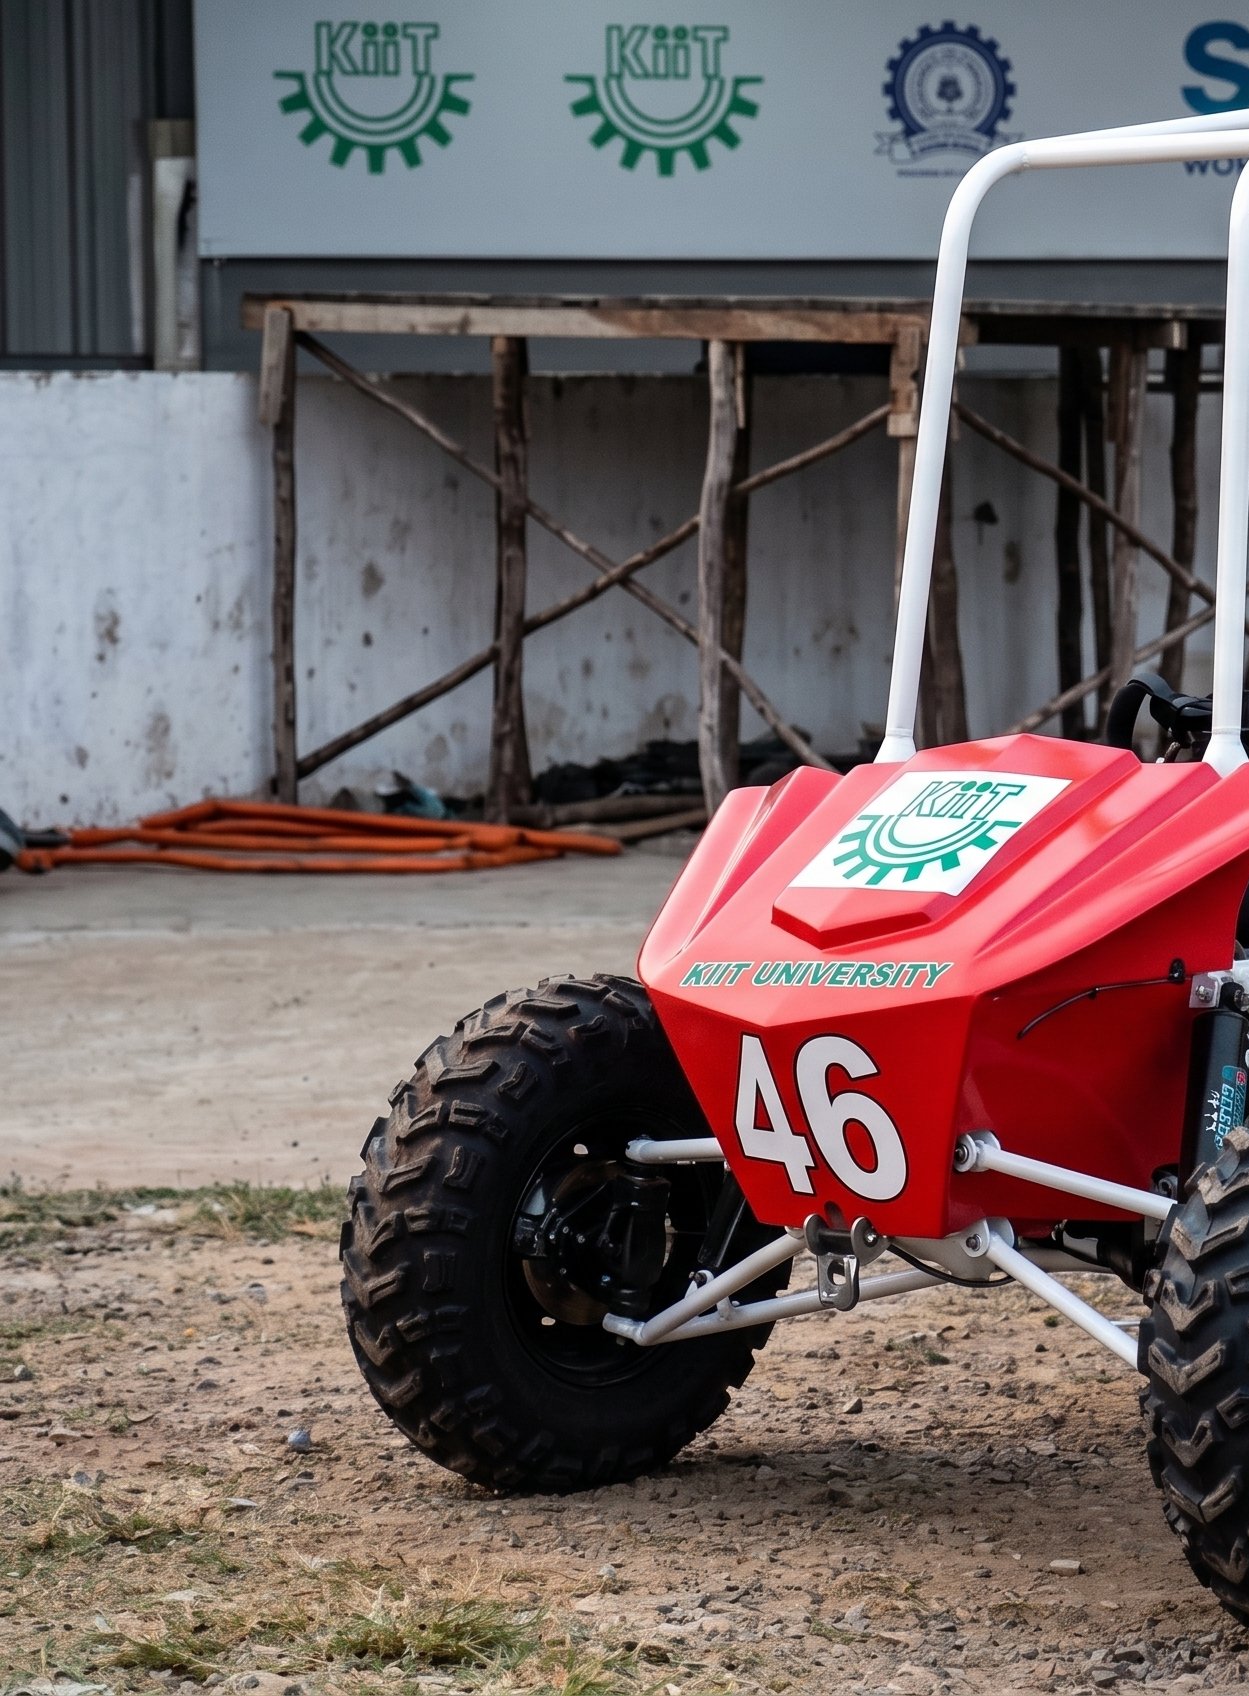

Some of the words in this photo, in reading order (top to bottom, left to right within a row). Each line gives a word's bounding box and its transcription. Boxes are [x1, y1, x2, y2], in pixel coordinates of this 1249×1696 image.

[680, 961, 752, 987] KIIT
[751, 961, 954, 988] UNIVERSITY
[734, 1031, 908, 1202] 46
